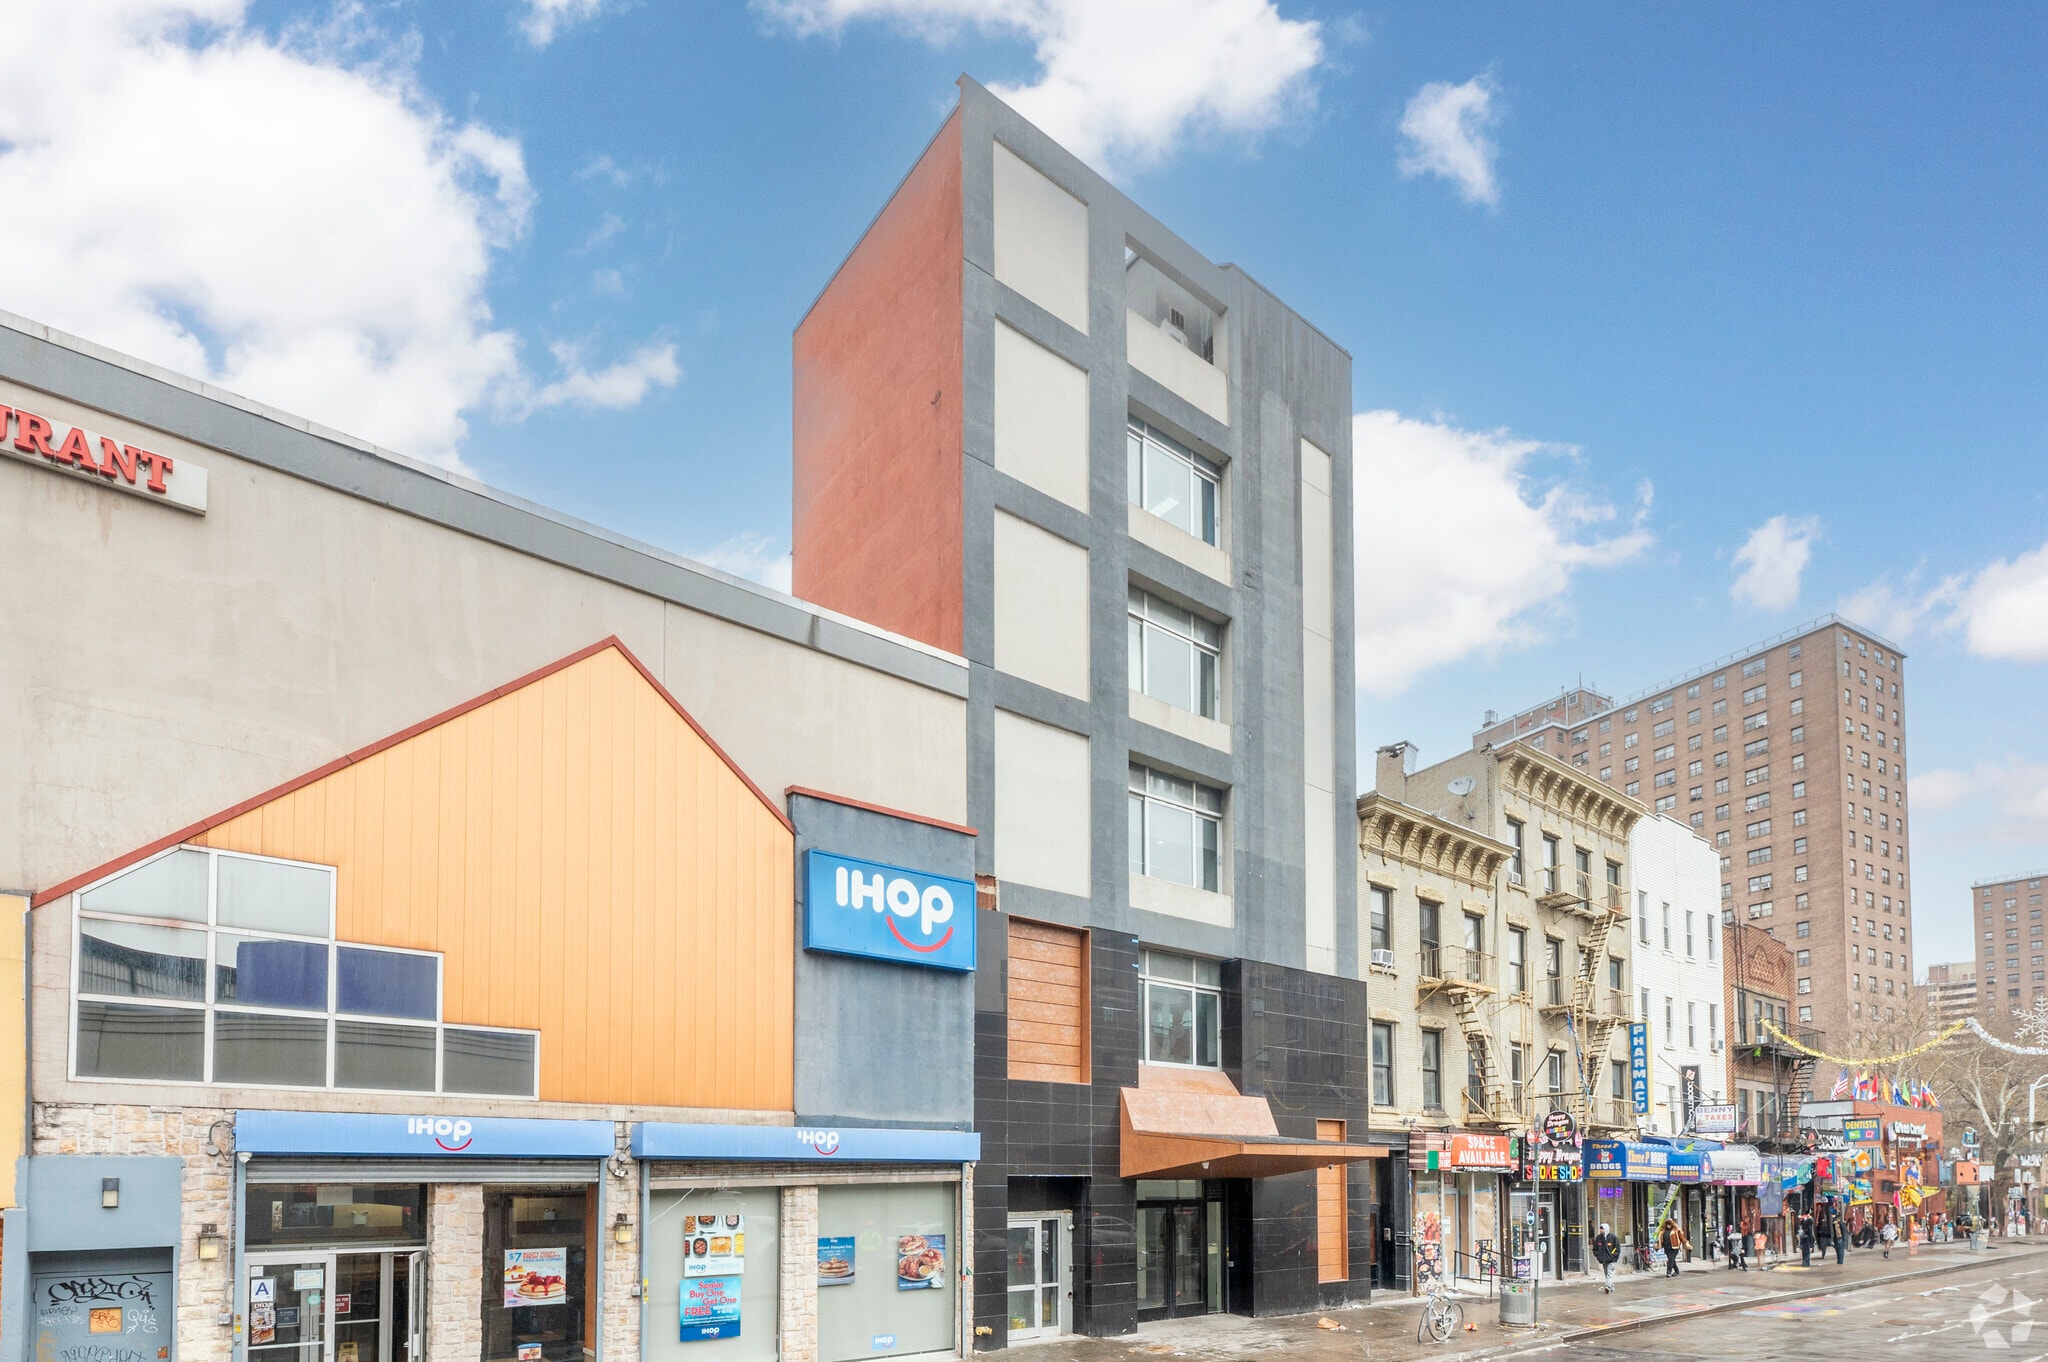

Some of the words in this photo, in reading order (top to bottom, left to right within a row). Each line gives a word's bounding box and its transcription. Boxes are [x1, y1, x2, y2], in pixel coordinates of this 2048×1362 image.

[1632, 1025, 1647, 1112] PHARMACY
[1696, 1106, 1734, 1114] BENNY
[1845, 1120, 1878, 1130] DENTISTA
[1467, 1136, 1496, 1149] SPACE
[1458, 1150, 1507, 1165] AVAILABLE
[1526, 1147, 1554, 1164] Hppy
[1559, 1165, 1583, 1180] SHOP
[508, 1251, 522, 1262] $7
[255, 1282, 269, 1296] A
[698, 1281, 724, 1289] Senior
[689, 1290, 705, 1298] Buy
[702, 1297, 718, 1305] Get
[719, 1296, 737, 1304] One
[685, 1305, 712, 1316] FREE
